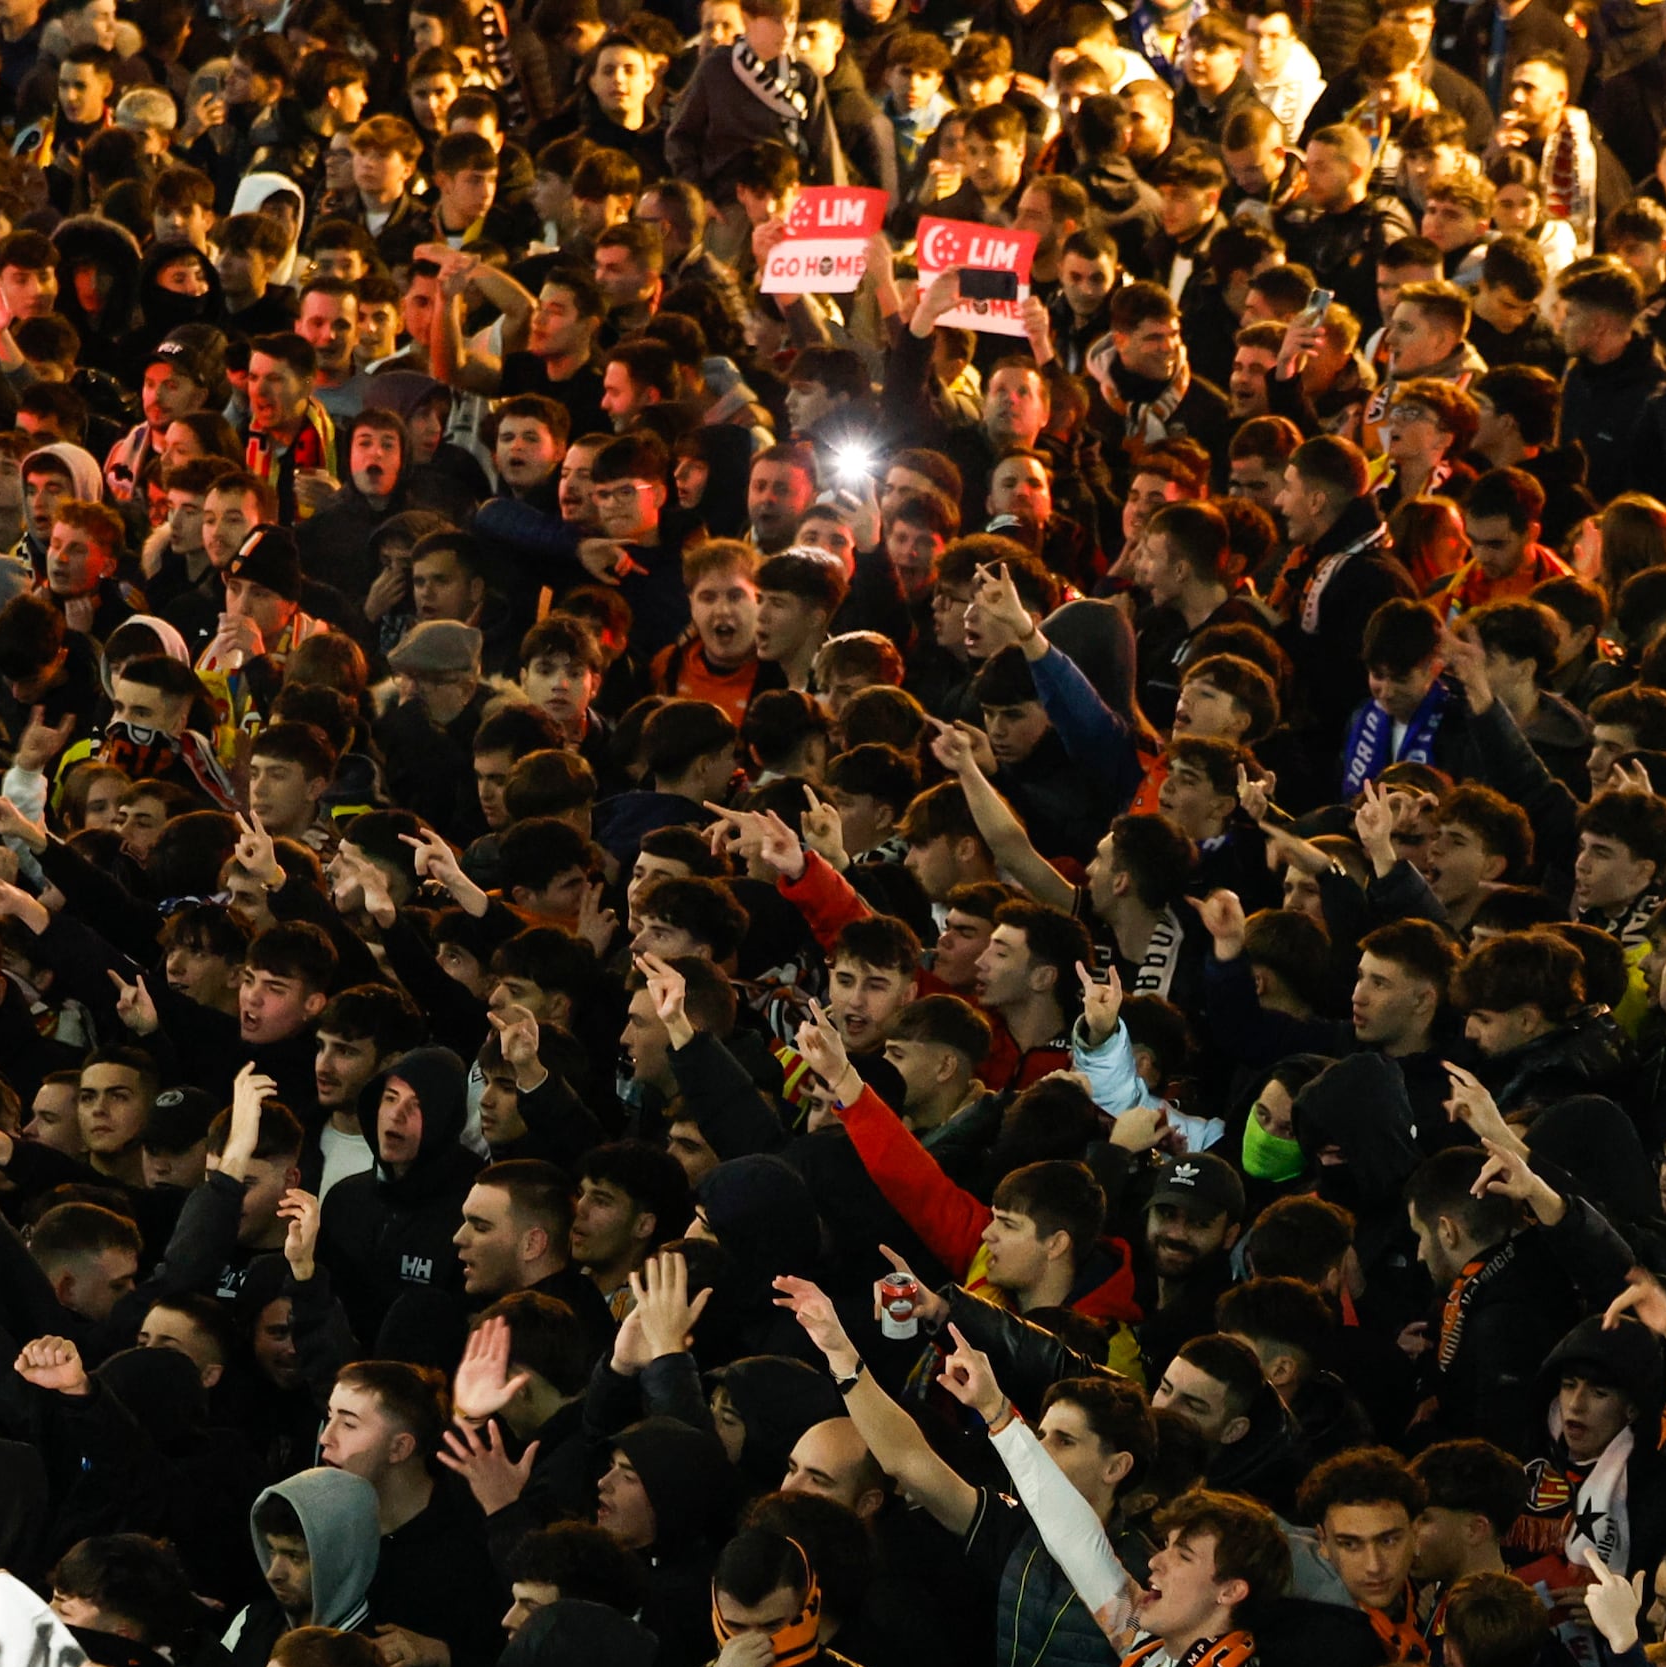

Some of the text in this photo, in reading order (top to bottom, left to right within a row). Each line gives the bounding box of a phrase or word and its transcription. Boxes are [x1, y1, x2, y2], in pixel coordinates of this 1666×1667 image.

[818, 199, 868, 227] LIM
[770, 257, 801, 277] GO
[968, 238, 1020, 270] LIM
